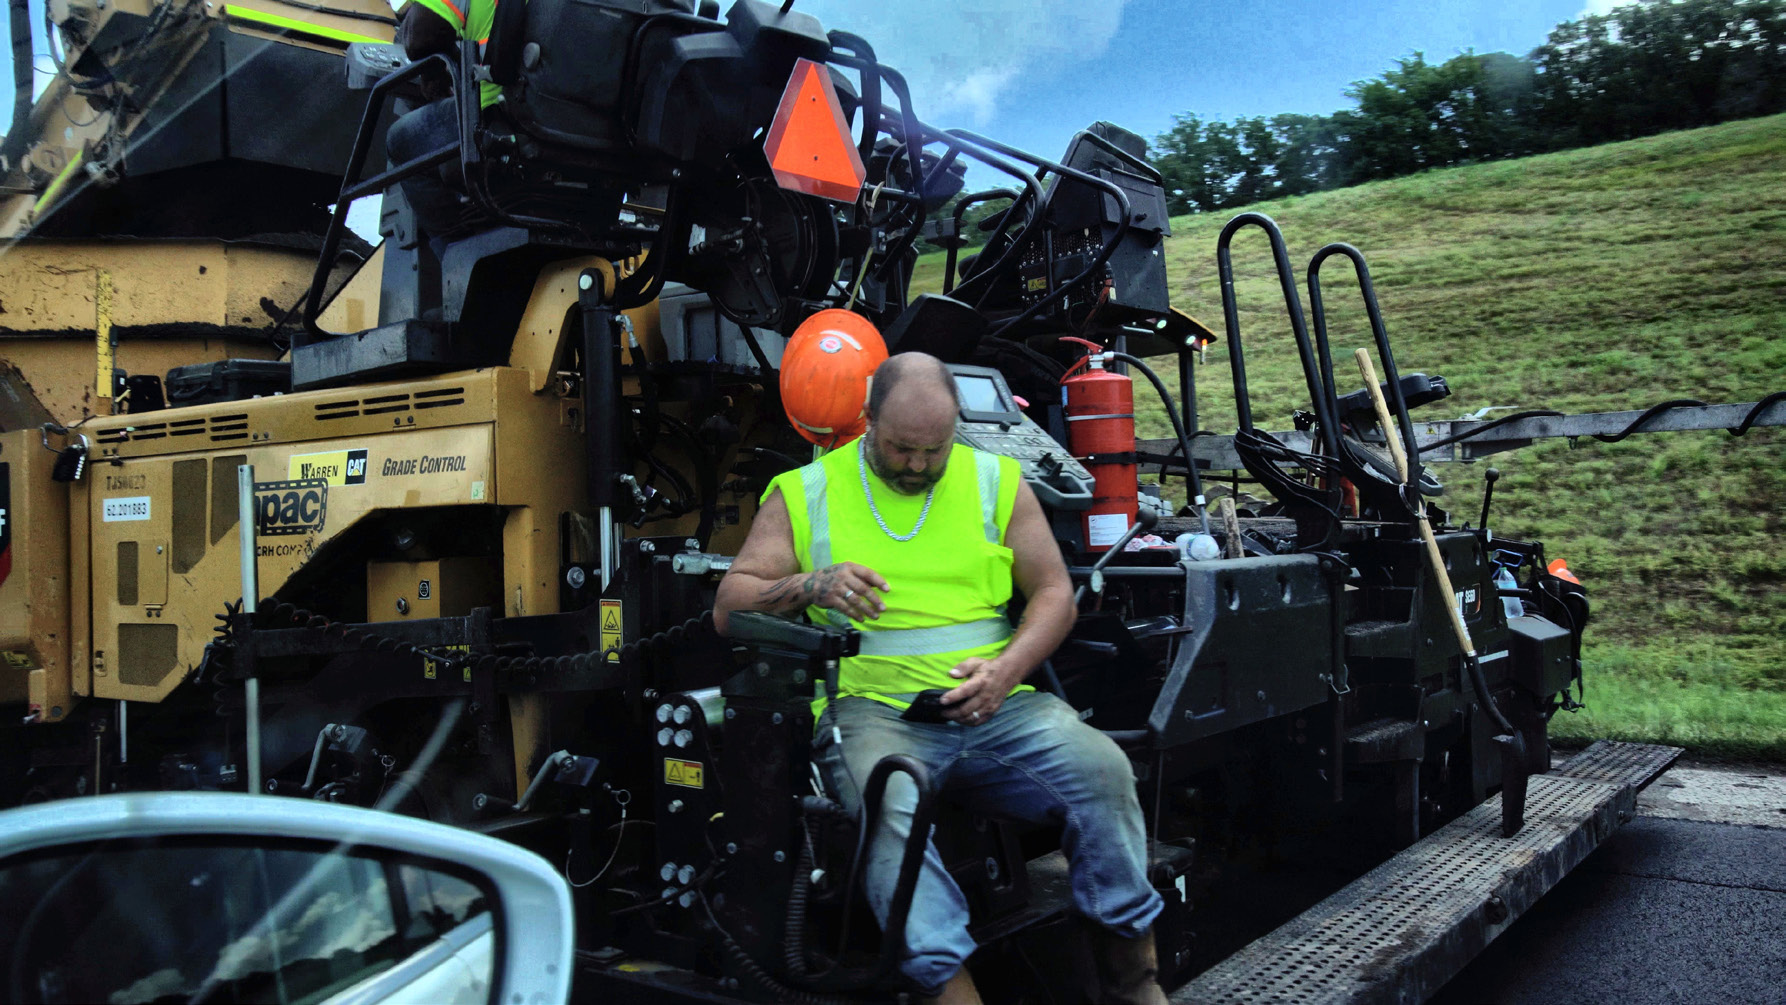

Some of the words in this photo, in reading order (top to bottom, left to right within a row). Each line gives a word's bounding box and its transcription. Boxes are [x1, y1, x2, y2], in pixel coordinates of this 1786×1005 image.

[301, 463, 339, 479] WARREN
[347, 458, 366, 476] CAT
[382, 458, 417, 476] GRADE
[419, 455, 466, 475] CONTROL
